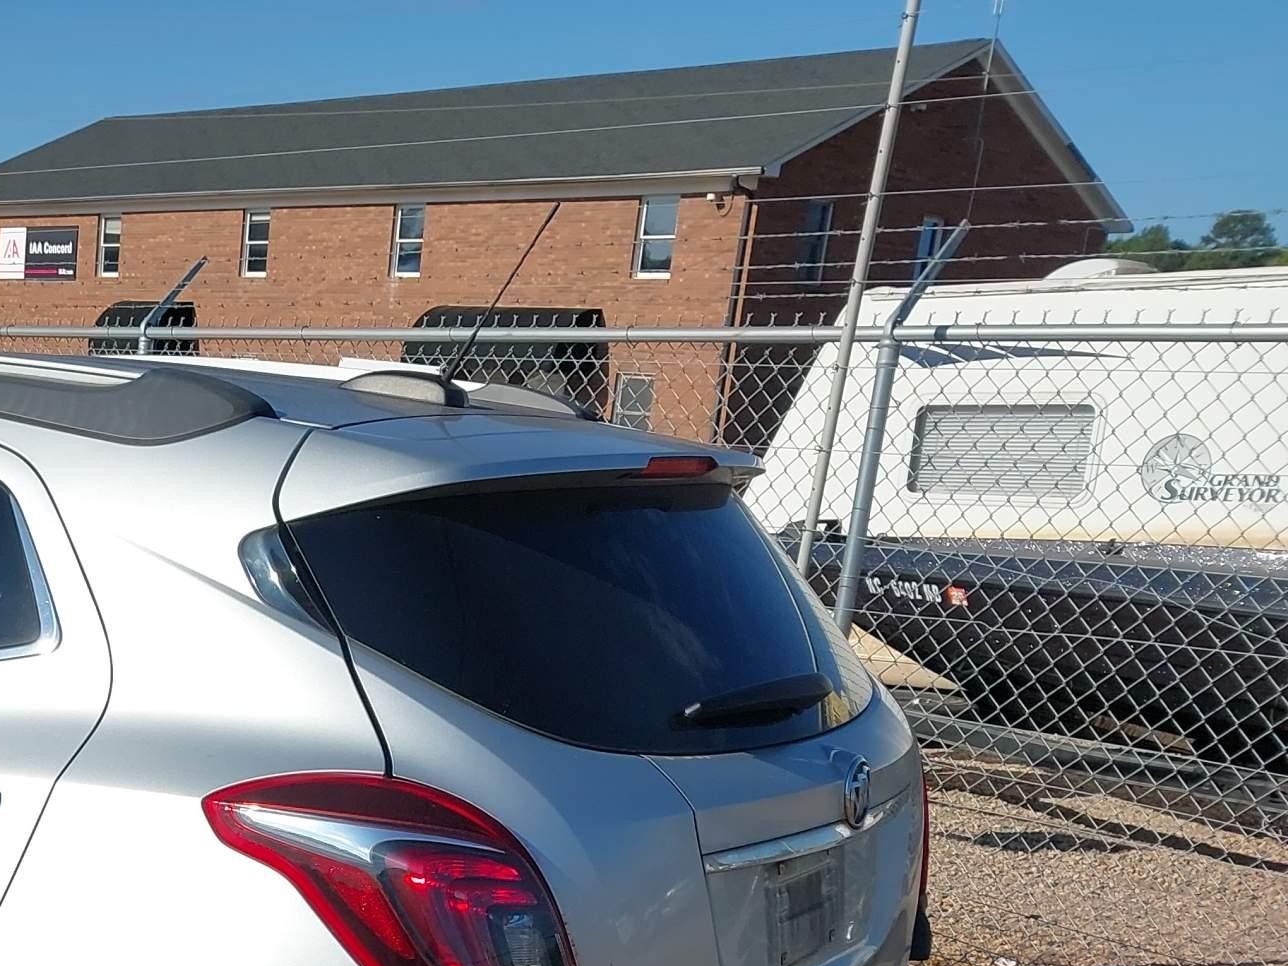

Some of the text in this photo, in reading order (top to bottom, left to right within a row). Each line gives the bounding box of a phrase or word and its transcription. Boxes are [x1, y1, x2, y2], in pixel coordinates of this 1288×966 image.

[29, 240, 73, 255] IAA Concord
[1209, 474, 1281, 488] GRAND
[1160, 478, 1282, 504] SURVEYOR
